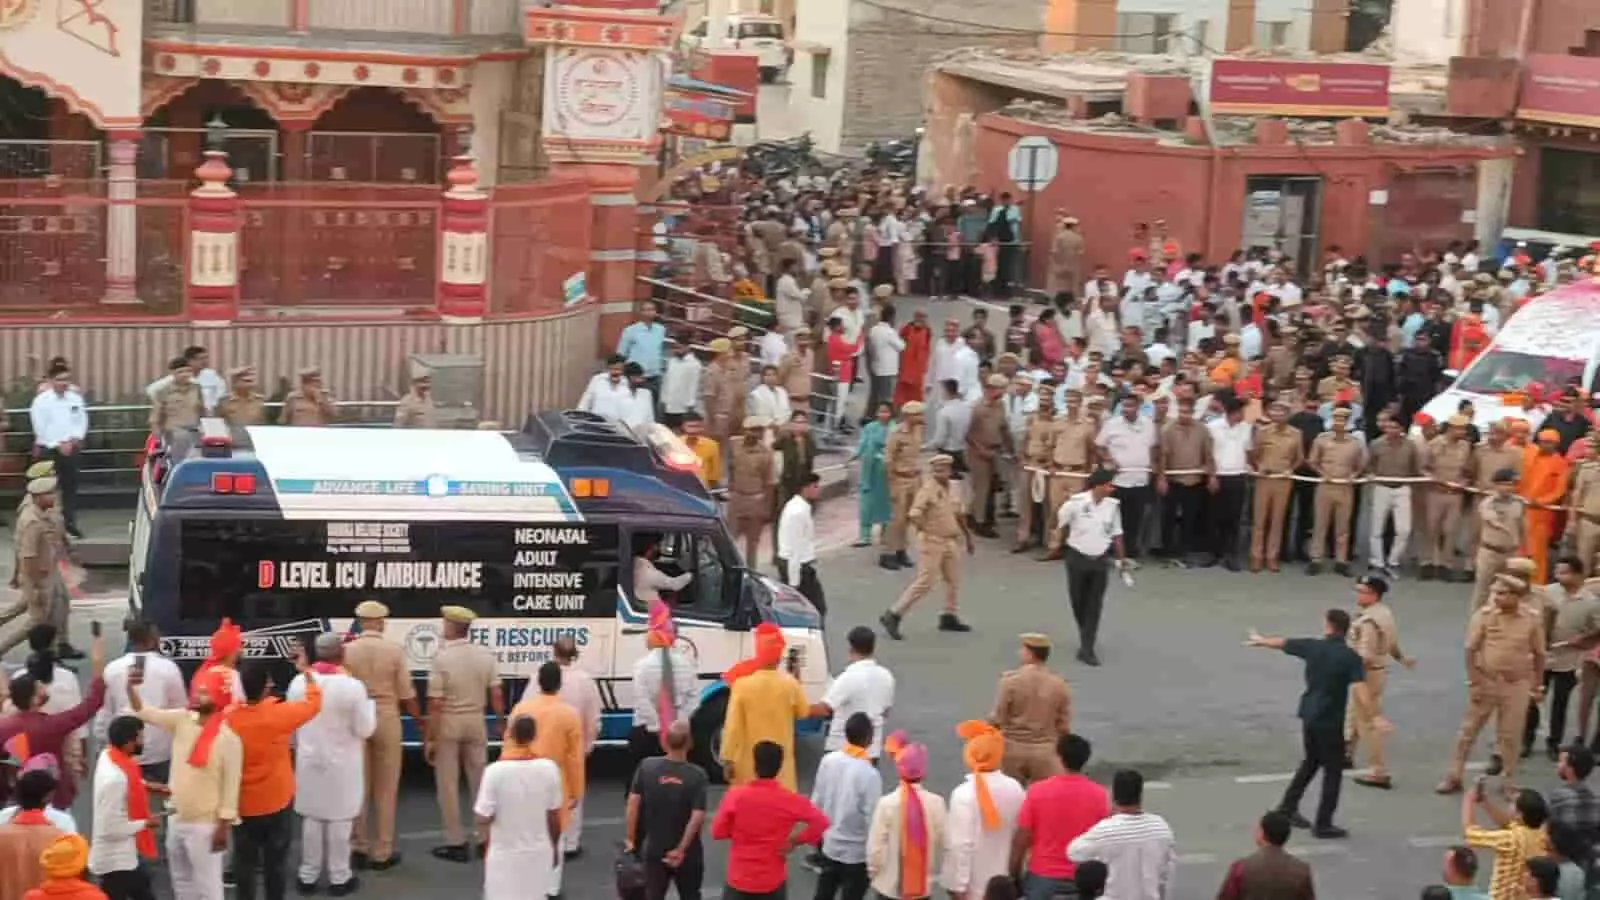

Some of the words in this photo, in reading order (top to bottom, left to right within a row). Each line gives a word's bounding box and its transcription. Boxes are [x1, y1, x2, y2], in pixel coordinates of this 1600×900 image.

[312, 481, 380, 494] ADVANCE
[385, 481, 415, 494] LIFE
[459, 483, 510, 495] SAVING
[513, 484, 545, 495] UNIT
[514, 528, 589, 544] NEONATAL
[513, 551, 558, 566] ADULT
[258, 560, 275, 588] D
[279, 561, 332, 588] LEVEL
[335, 561, 367, 588] ICU
[374, 561, 483, 588] AMBULANCE
[513, 573, 583, 588] INTENSIVE
[513, 595, 552, 610] CARE
[554, 595, 586, 610] UNIT
[469, 628, 489, 646] FE
